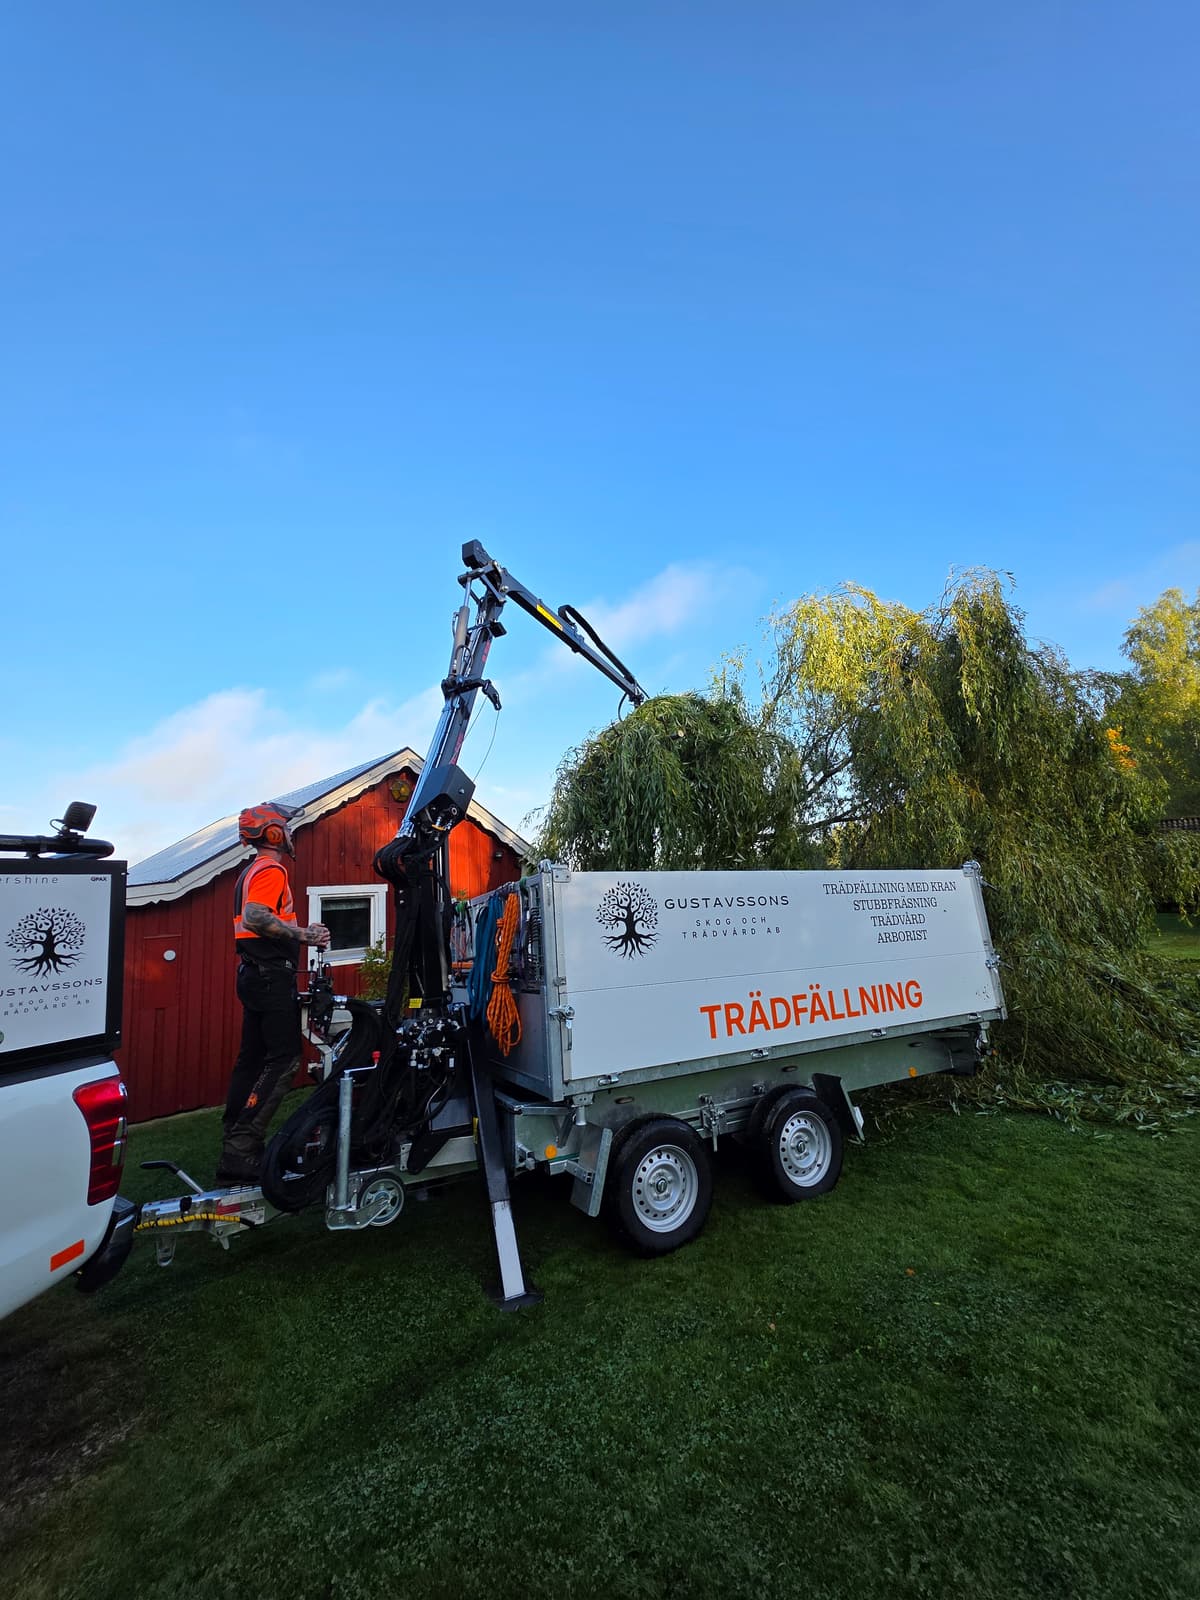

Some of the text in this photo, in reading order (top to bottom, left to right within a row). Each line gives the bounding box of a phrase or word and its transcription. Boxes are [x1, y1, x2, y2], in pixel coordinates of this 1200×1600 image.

[823, 880, 957, 895] TRÄDFÄLLNING MED KRAN
[664, 895, 790, 910] GUSTAVSSONS
[853, 895, 938, 911] STUBBFRÄSNING
[695, 916, 767, 927] SKOG OCH
[870, 911, 926, 928] TRÄDVÅRD
[766, 926, 781, 935] AB
[877, 929, 928, 944] ARBORIST
[54, 993, 78, 1002] OCH
[699, 979, 924, 1040] TRÄDFÄLLNING
